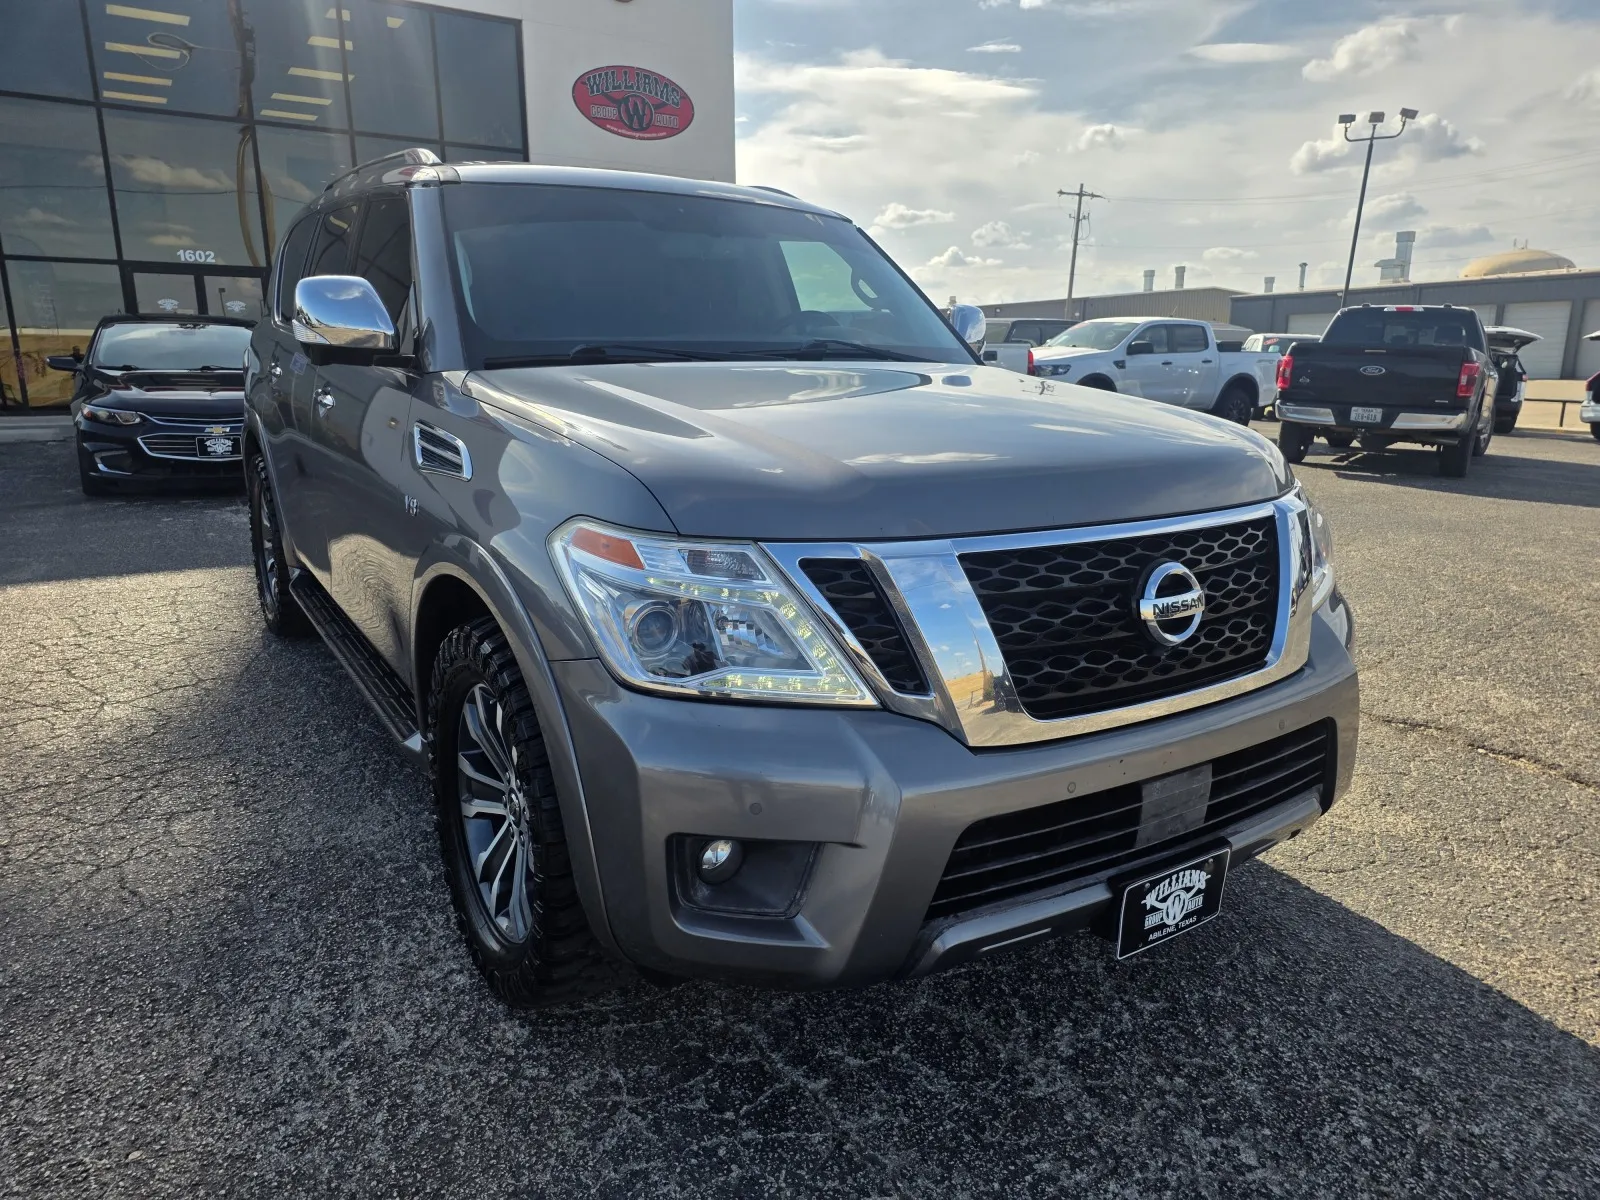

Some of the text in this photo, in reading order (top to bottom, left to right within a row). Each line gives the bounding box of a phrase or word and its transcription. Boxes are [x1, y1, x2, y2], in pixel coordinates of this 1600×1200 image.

[586, 70, 680, 108] WILLIAMS
[591, 105, 618, 119] GROUP
[655, 114, 679, 128] AUTO
[176, 249, 216, 263] 1602
[1152, 596, 1204, 616] NISSAN
[1145, 869, 1206, 911] WILLIAMS
[1144, 911, 1164, 928] GROUP
[1187, 896, 1204, 911] AUTO
[1148, 915, 1197, 941] ABILENE, TEXAS
